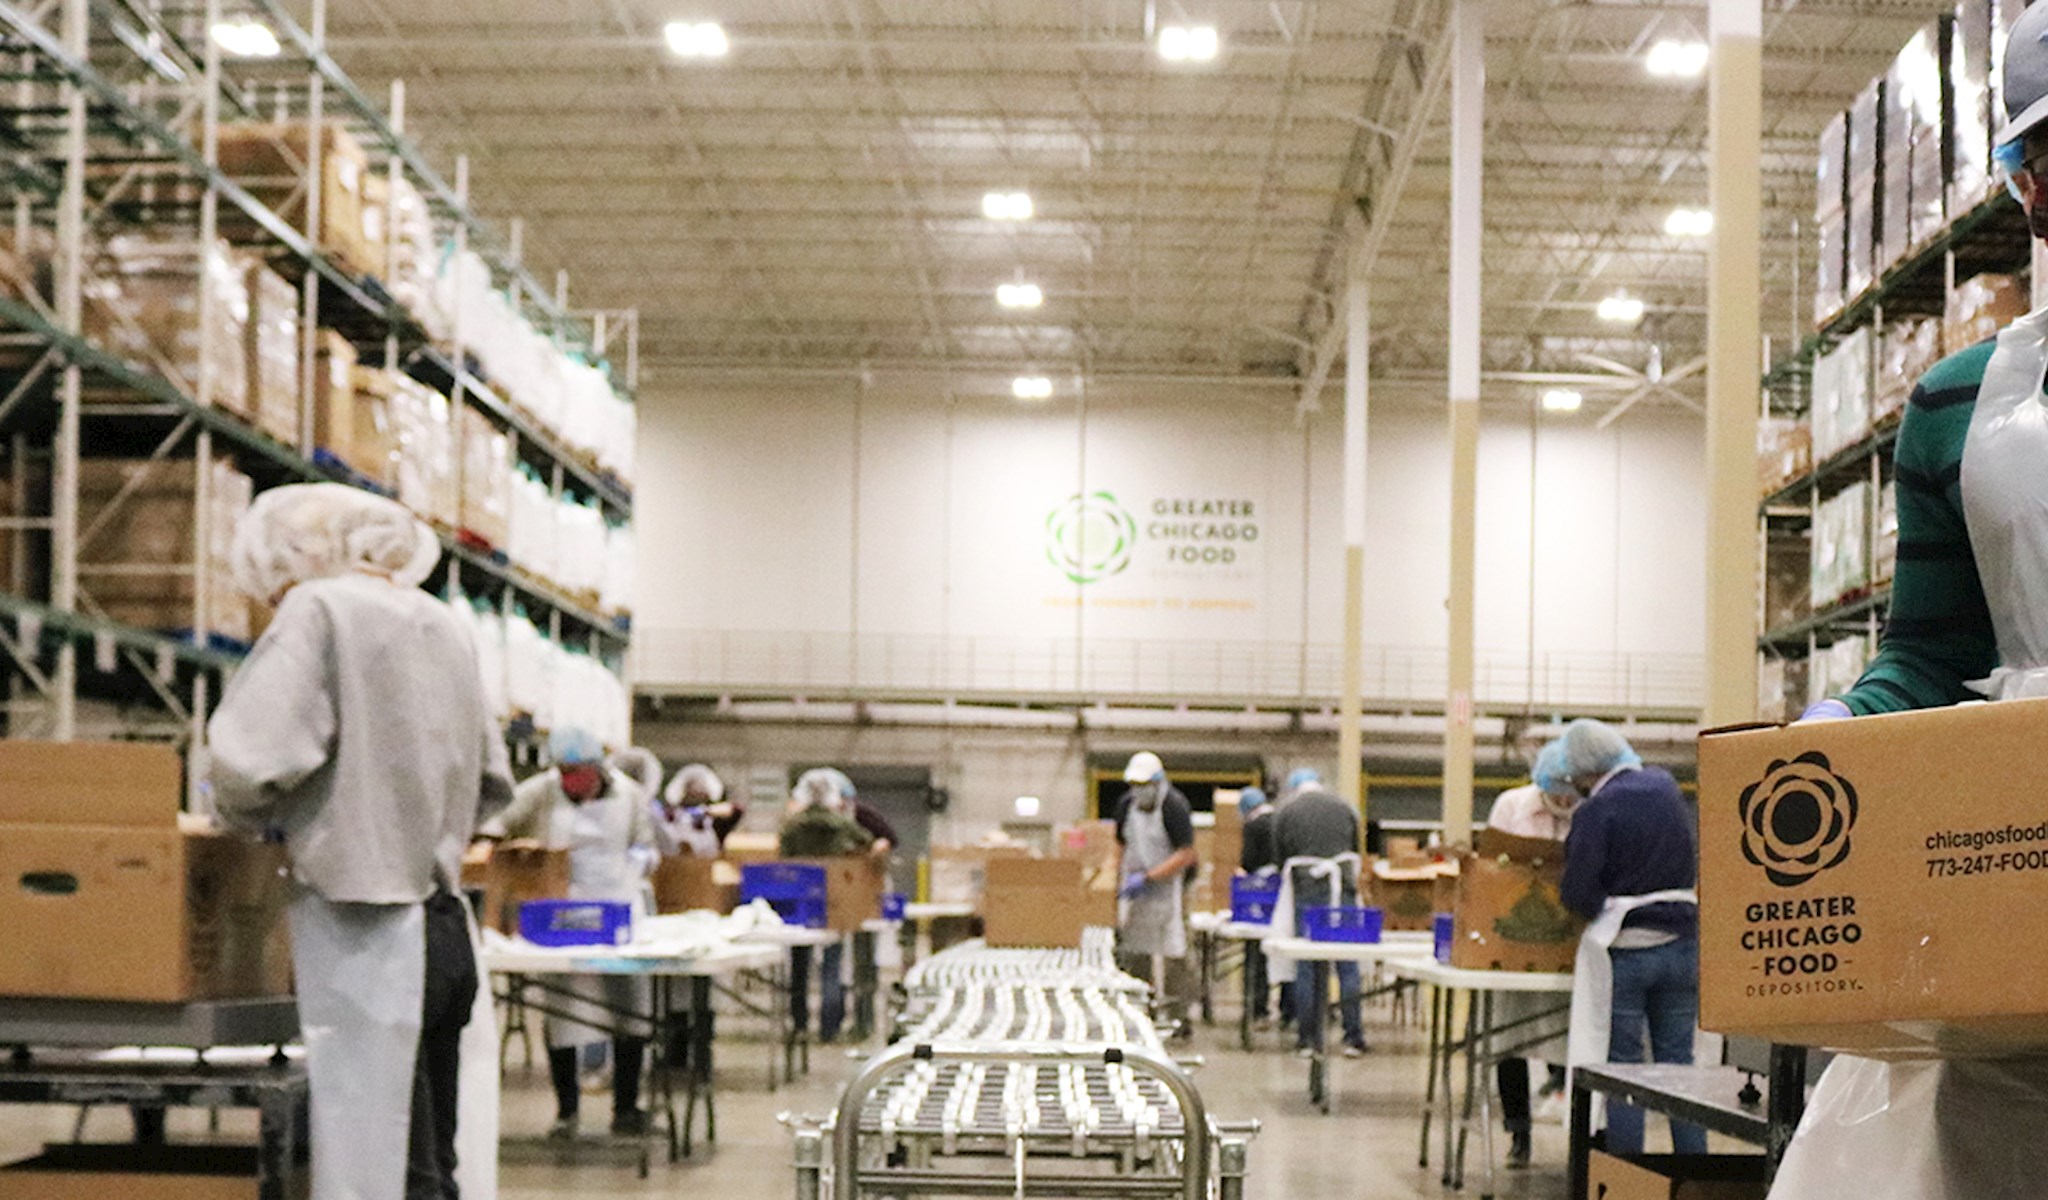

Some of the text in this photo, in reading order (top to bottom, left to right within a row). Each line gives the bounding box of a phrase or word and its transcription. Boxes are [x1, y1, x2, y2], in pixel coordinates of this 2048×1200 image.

[1152, 499, 1254, 516] GREATER
[1148, 523, 1259, 541] CHICAGO
[1168, 547, 1237, 563] FOOD
[1926, 823, 2048, 850] chicagosfood
[1746, 896, 1856, 922] GREATER
[1741, 923, 1862, 950] CHICAGO
[1763, 954, 1838, 976] FOOD
[1746, 979, 1859, 997] DEPOSITORY
